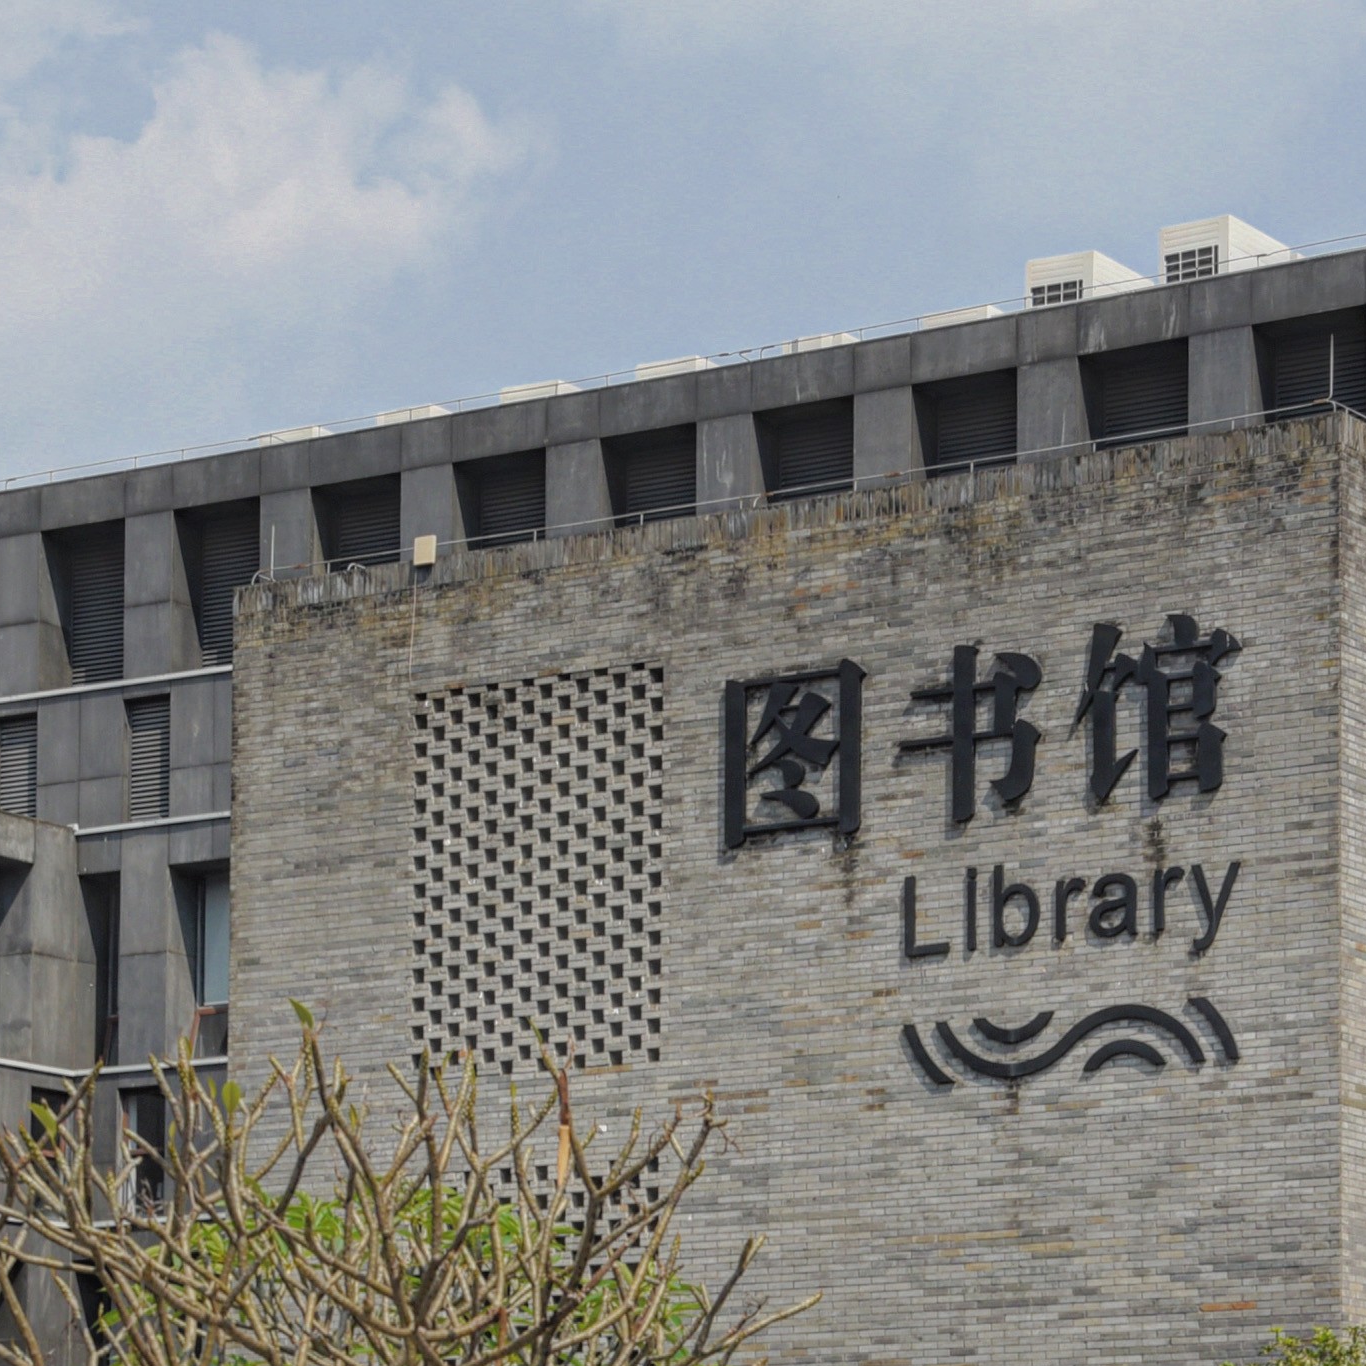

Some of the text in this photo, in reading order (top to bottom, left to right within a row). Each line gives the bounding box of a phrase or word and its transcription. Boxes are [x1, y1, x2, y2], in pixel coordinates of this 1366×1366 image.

[723, 613, 1243, 850] 图书馆
[902, 860, 1242, 957] Library
